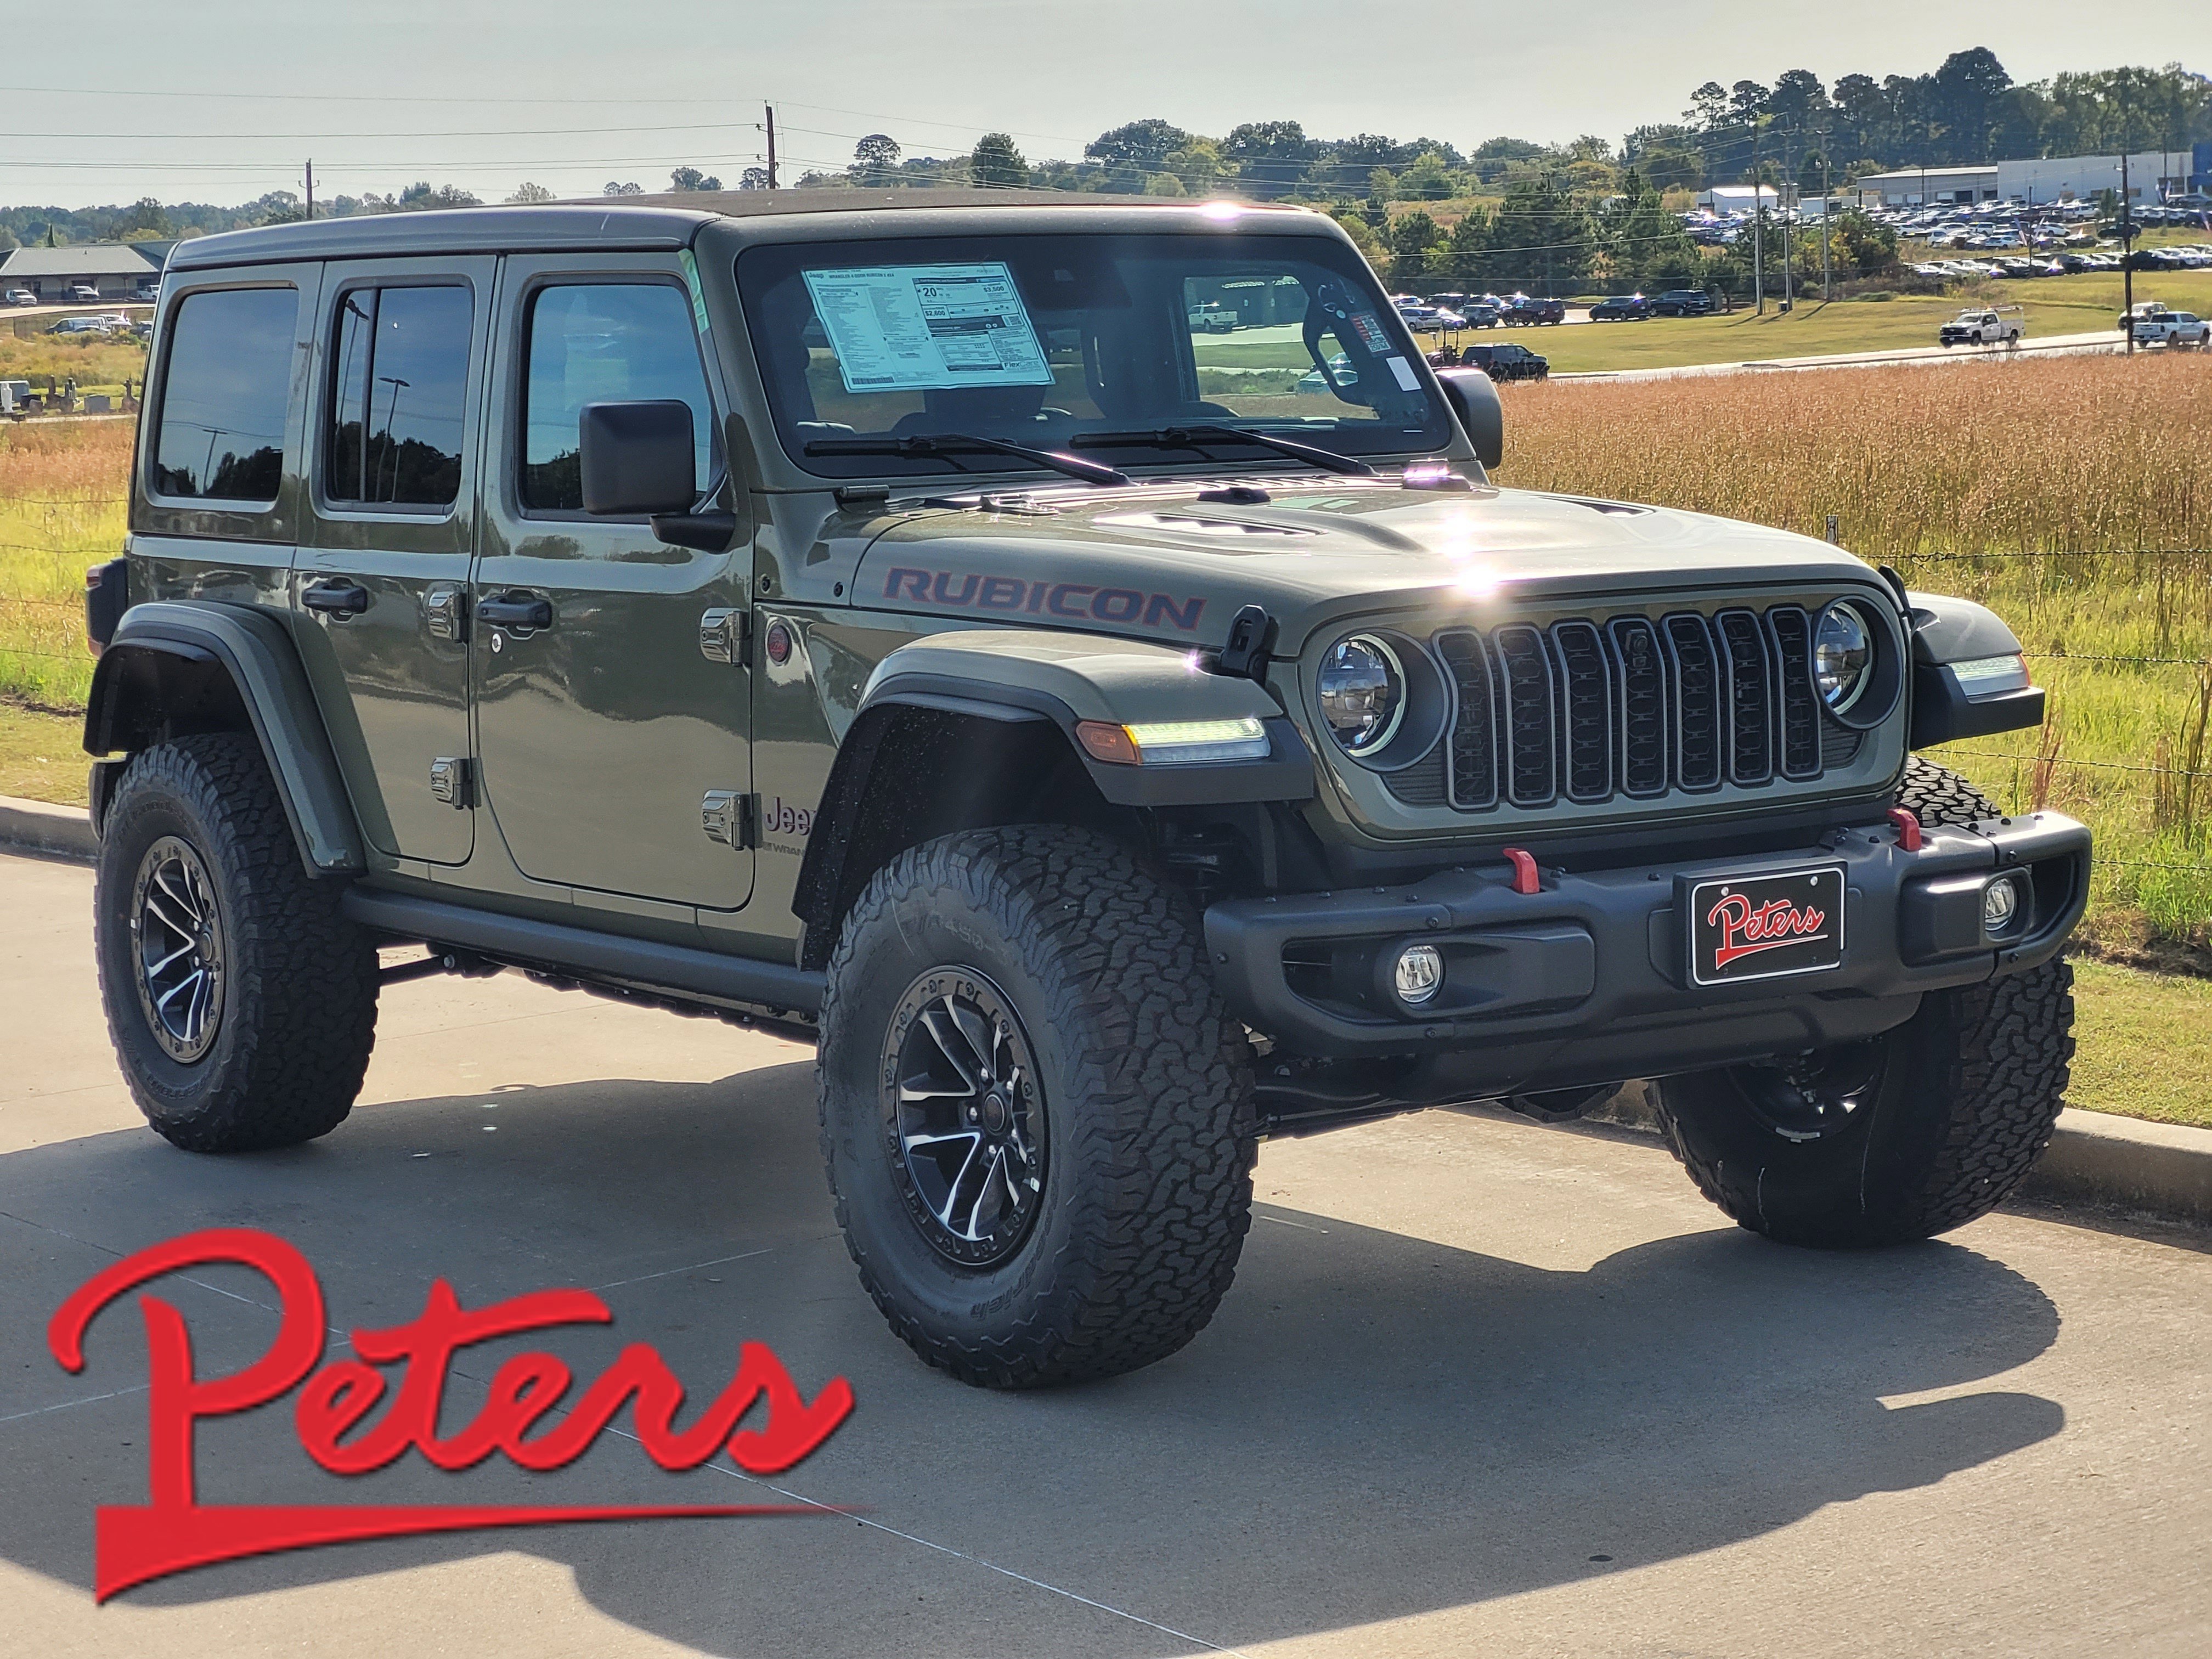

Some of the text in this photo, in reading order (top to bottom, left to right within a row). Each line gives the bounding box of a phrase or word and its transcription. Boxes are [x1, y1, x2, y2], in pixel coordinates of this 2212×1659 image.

[923, 287, 937, 297] 20
[882, 567, 1207, 631] RUBICON
[763, 796, 817, 836] Jee
[1708, 894, 1825, 951] Peters
